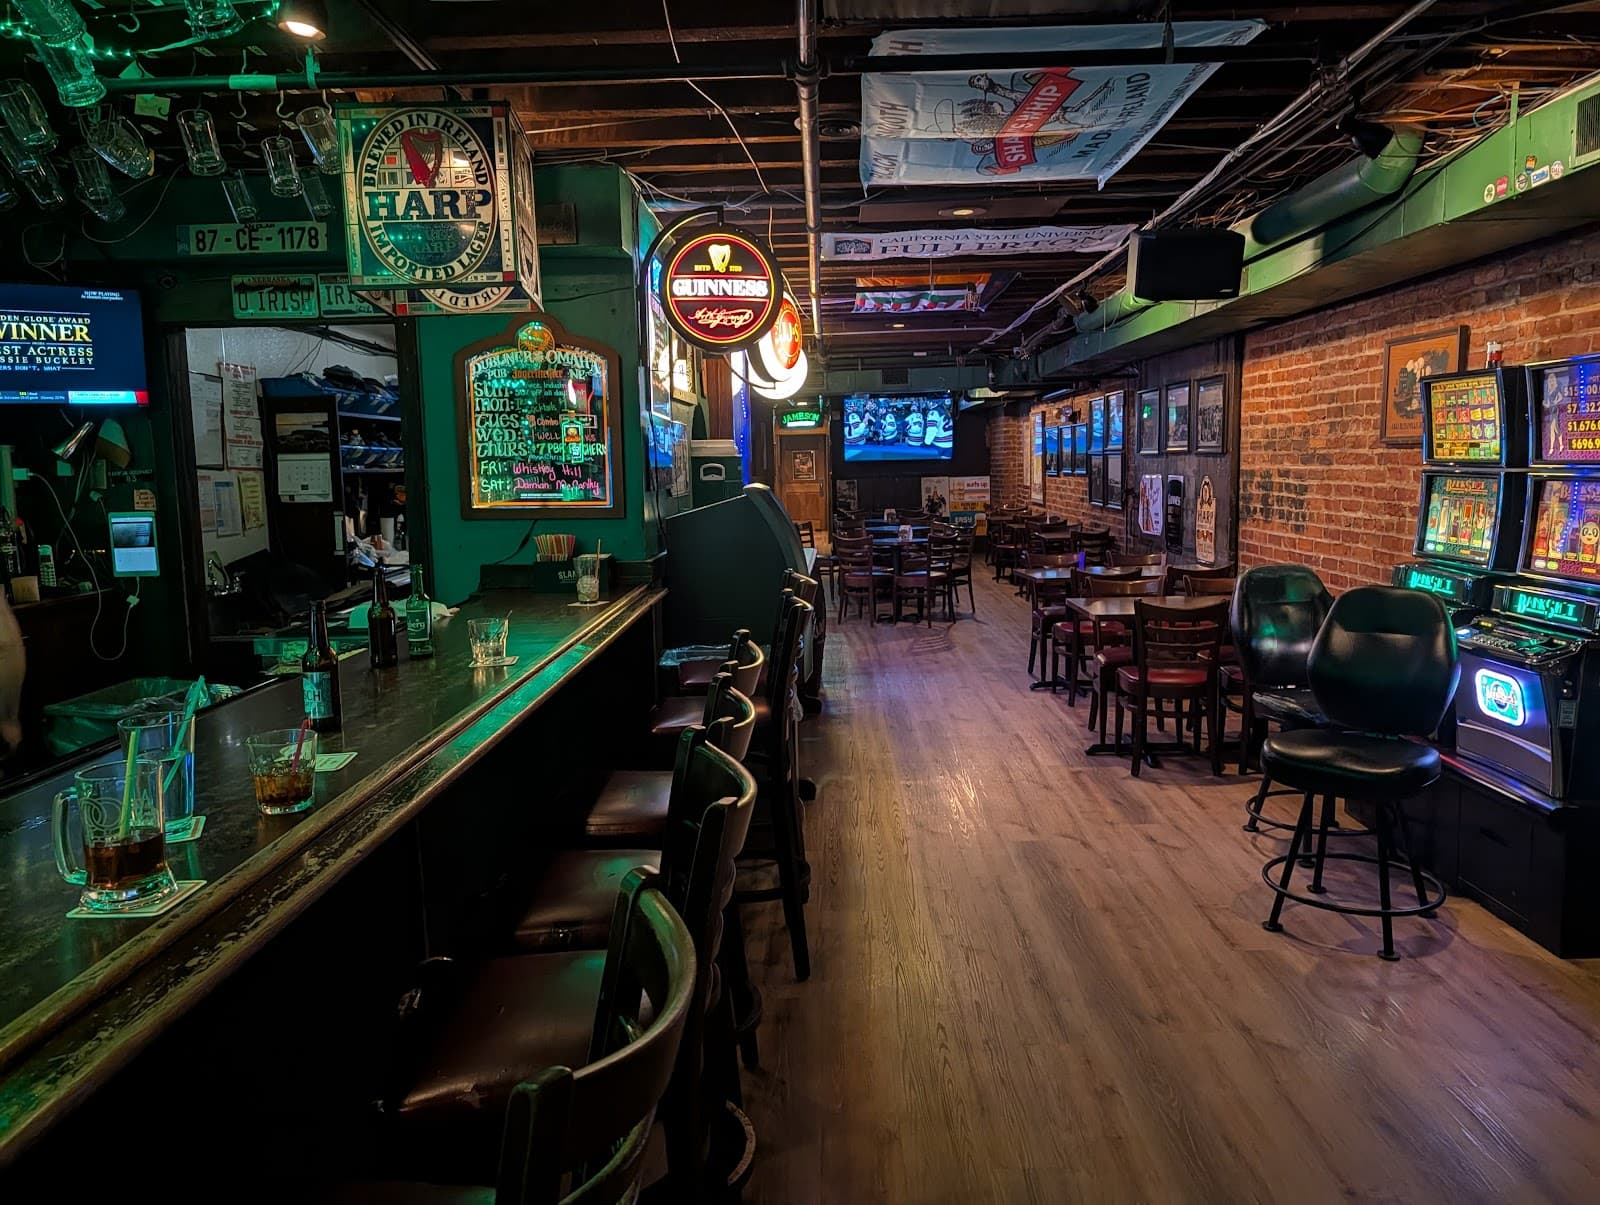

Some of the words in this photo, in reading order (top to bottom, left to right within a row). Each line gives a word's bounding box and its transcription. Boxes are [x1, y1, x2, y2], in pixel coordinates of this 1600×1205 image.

[1018, 85, 1062, 121] WHIP
[363, 119, 405, 187] BREWED
[407, 113, 430, 127] IN
[434, 113, 488, 186] IRELAND
[364, 189, 491, 220] HARP
[879, 234, 971, 245] CALIFORNIA
[974, 231, 1019, 241] STATE
[880, 236, 1107, 254] FULLERTON
[370, 224, 455, 281] IMPORTED
[460, 221, 491, 275] LAGER
[672, 279, 769, 297] GUINNESS
[258, 289, 311, 311] IRISH
[0, 346, 21, 356] ST
[27, 346, 94, 357] ACTRESS
[36, 357, 94, 365] BUCKLEY
[473, 350, 534, 376] DUBLINER
[546, 350, 603, 377] OMAHA
[487, 368, 508, 379] PUB
[568, 369, 588, 380] NE
[782, 412, 820, 424] JAMESON
[562, 464, 582, 477] Hill
